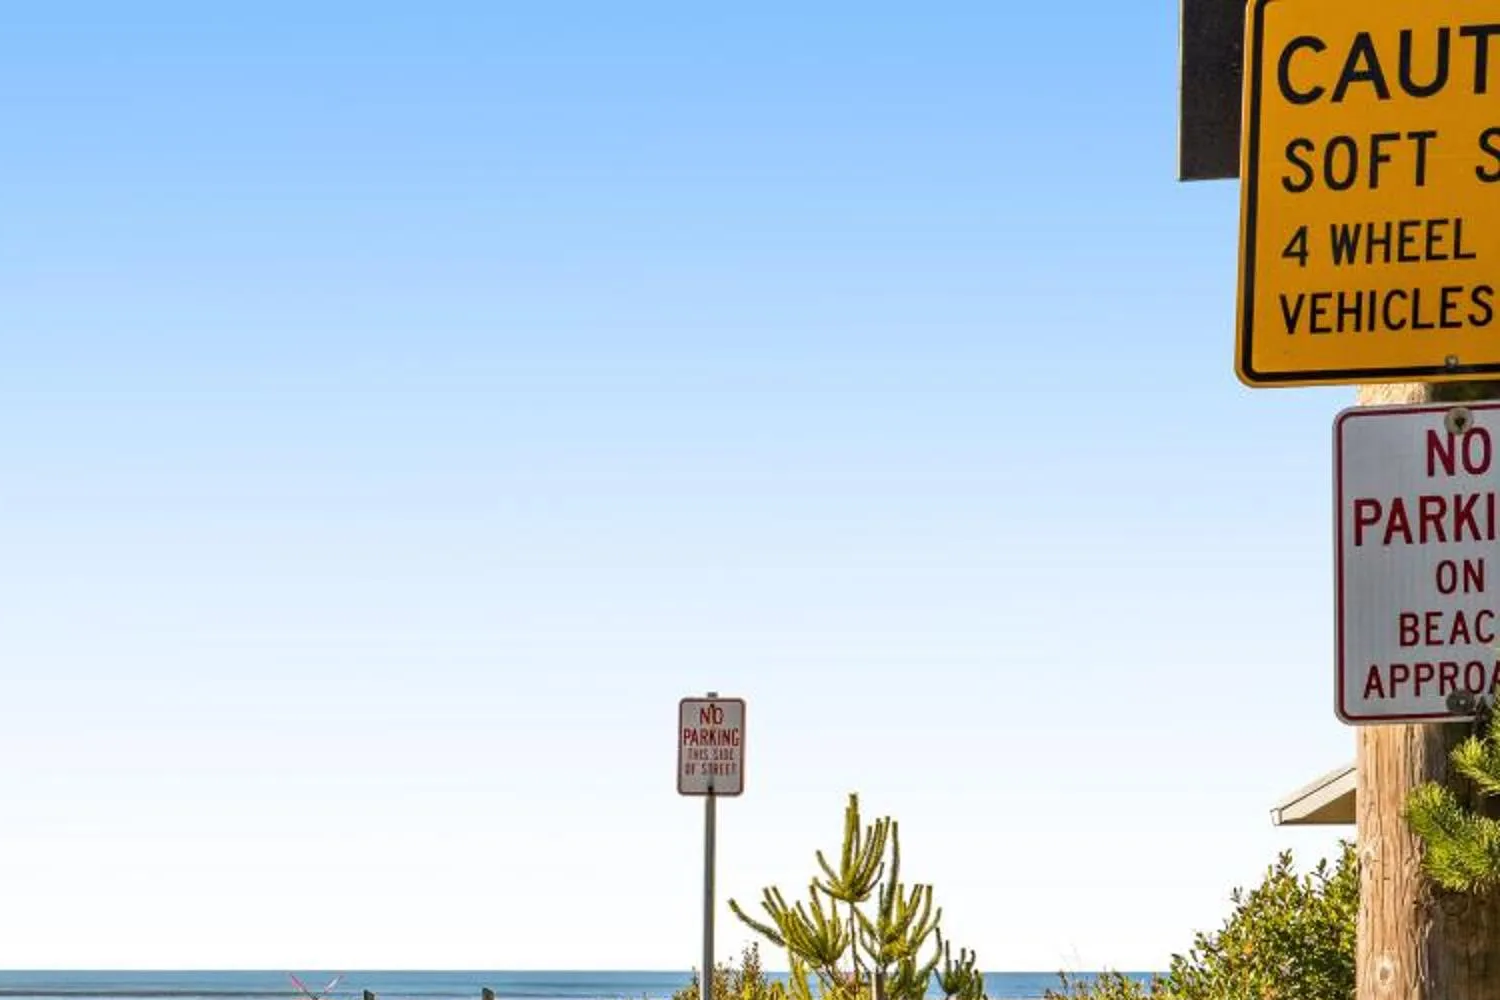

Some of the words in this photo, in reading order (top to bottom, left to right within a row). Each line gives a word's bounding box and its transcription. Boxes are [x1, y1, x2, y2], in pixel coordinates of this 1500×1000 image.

[1277, 24, 1500, 105] CAUT
[1281, 130, 1438, 193] SOFT
[1281, 225, 1309, 267] 4
[1329, 217, 1477, 266] WHEEL
[1279, 285, 1494, 335] VEHICLES
[1426, 426, 1491, 478] NO
[1353, 492, 1496, 547] PARKI
[1435, 558, 1485, 595] ON
[1399, 609, 1495, 647] BEAC
[683, 727, 740, 747] PARKING
[700, 707, 724, 725] NO
